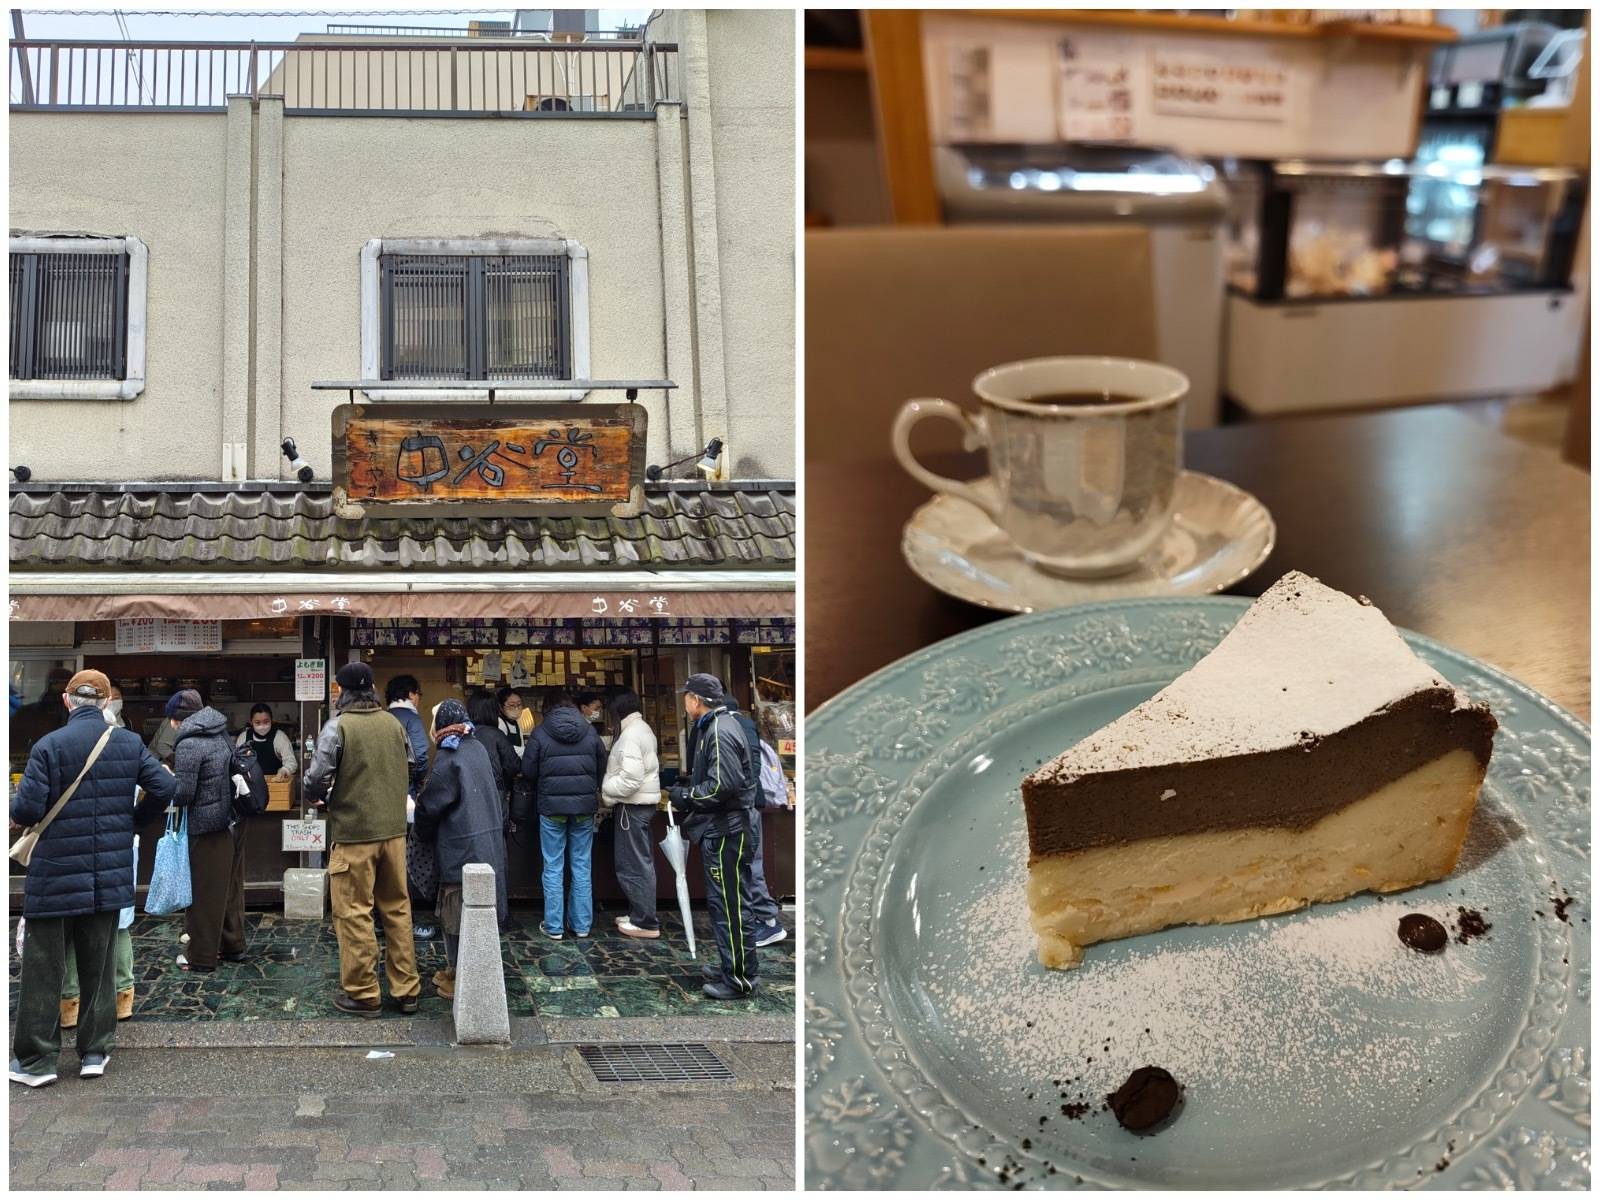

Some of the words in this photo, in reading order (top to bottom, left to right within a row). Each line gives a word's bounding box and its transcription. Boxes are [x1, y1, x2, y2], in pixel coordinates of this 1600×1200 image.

[397, 428, 603, 493] 中谷堂
[271, 596, 352, 614] 中谷堂
[591, 595, 672, 616] 中谷堂
